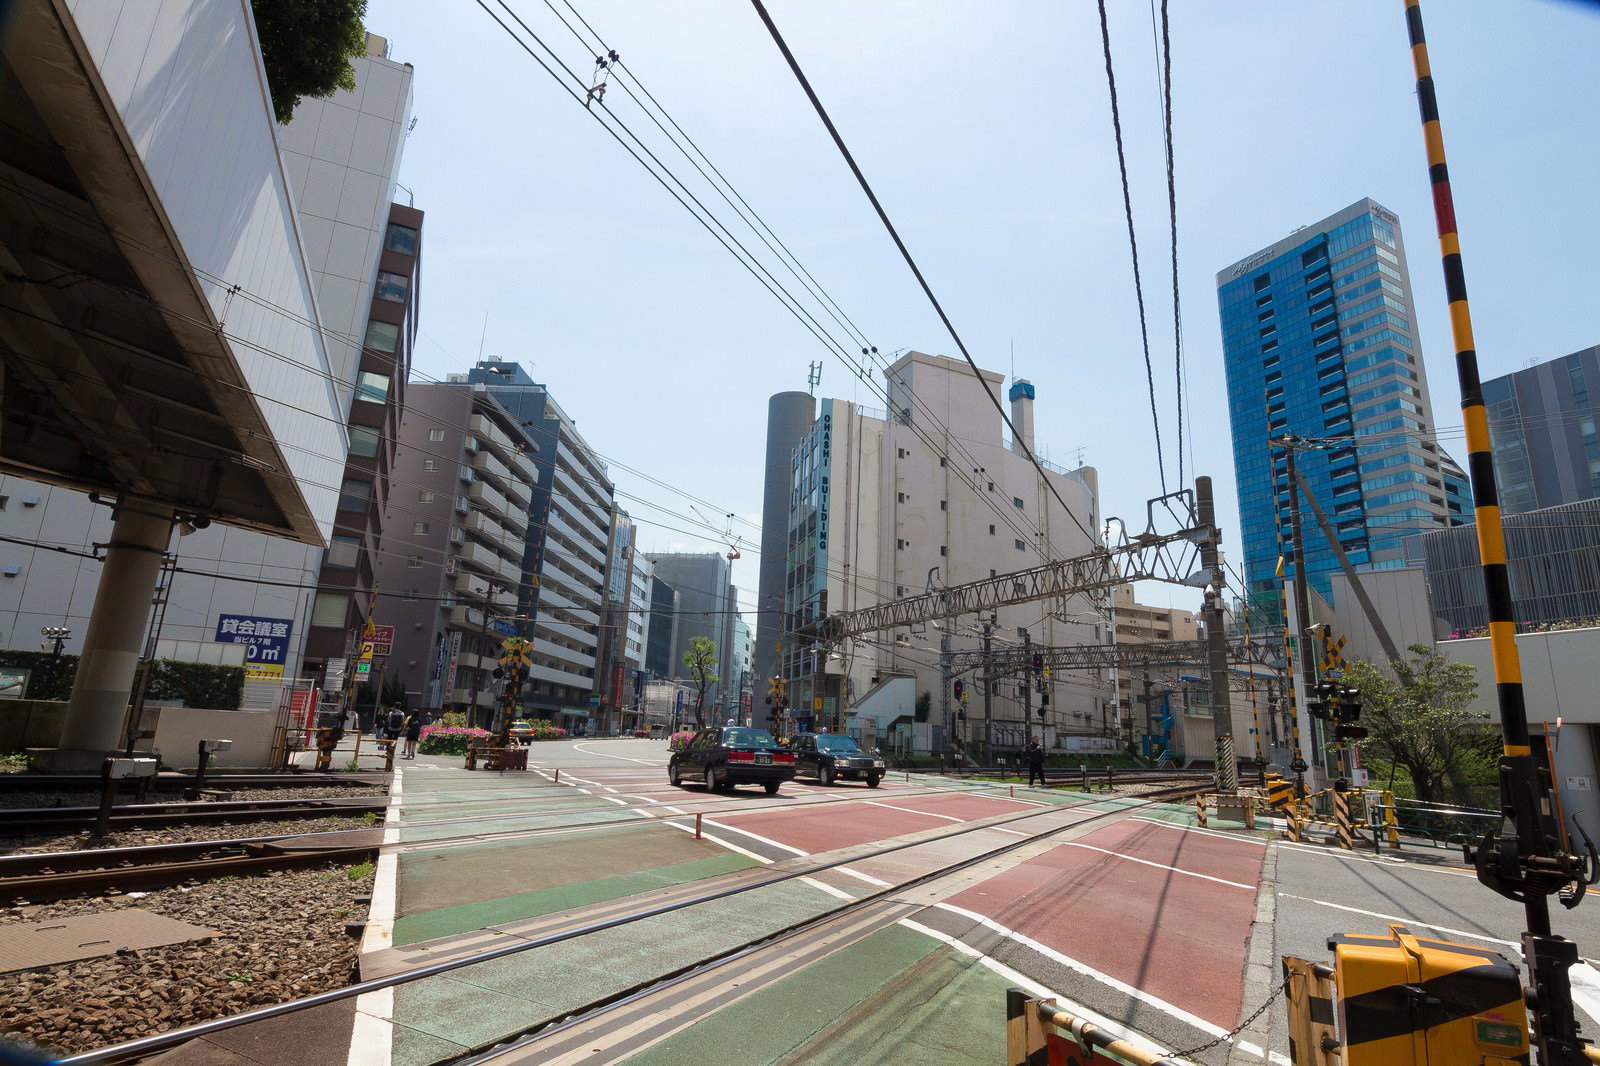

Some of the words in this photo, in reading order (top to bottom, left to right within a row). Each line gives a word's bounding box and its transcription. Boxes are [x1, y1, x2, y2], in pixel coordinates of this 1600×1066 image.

[823, 414, 831, 467] OHASHI
[819, 476, 828, 550] BUILDING
[221, 618, 288, 638] 貸会議室
